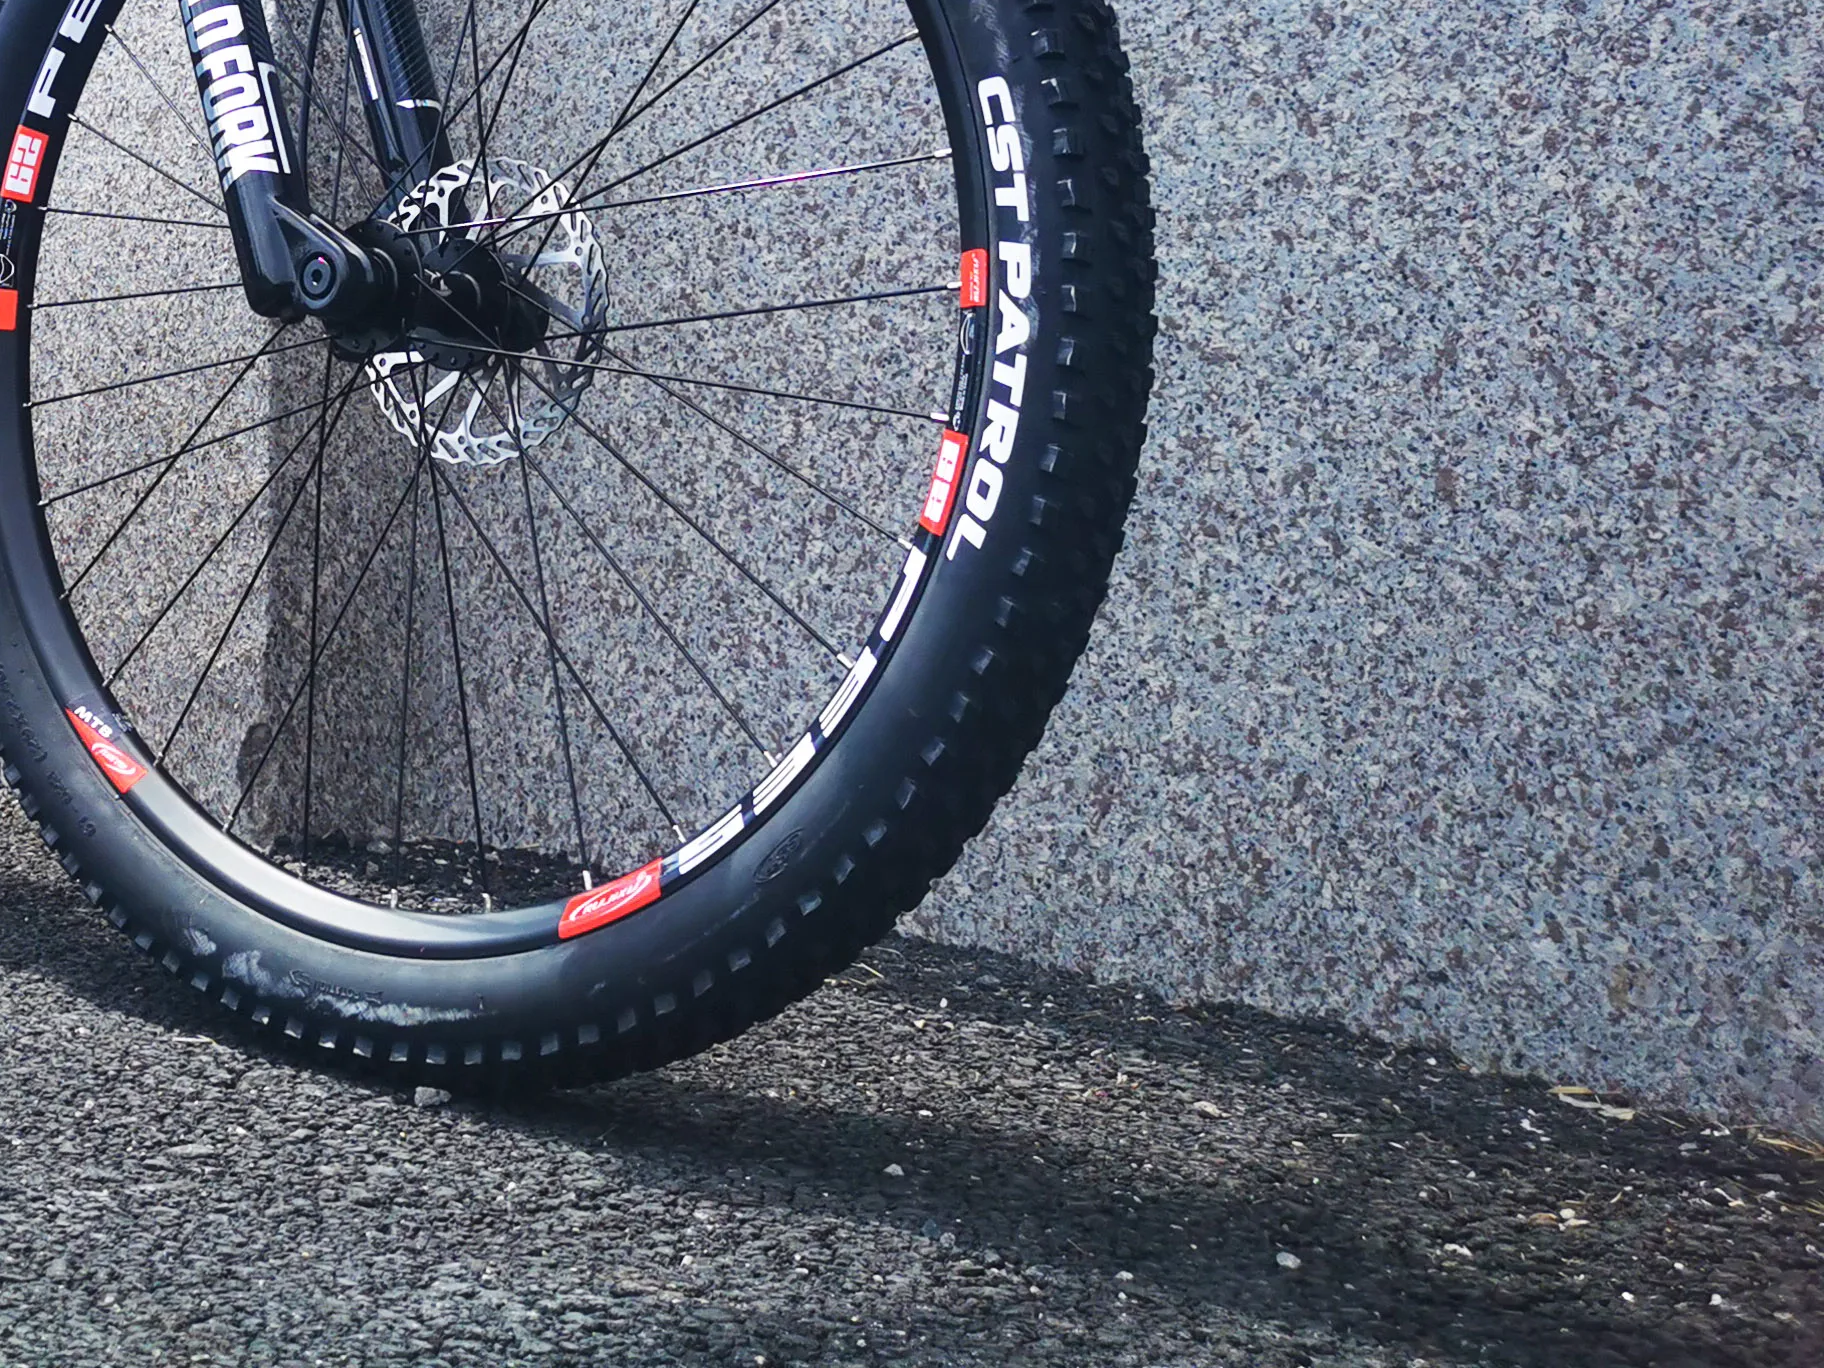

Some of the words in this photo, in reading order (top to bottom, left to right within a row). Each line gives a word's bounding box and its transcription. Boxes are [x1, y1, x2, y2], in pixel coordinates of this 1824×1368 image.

[4, 133, 42, 196] 29
[196, 44, 279, 192] FORK
[978, 75, 1030, 222] CST
[946, 241, 1031, 561] PATROL
[74, 705, 113, 738] MTB
